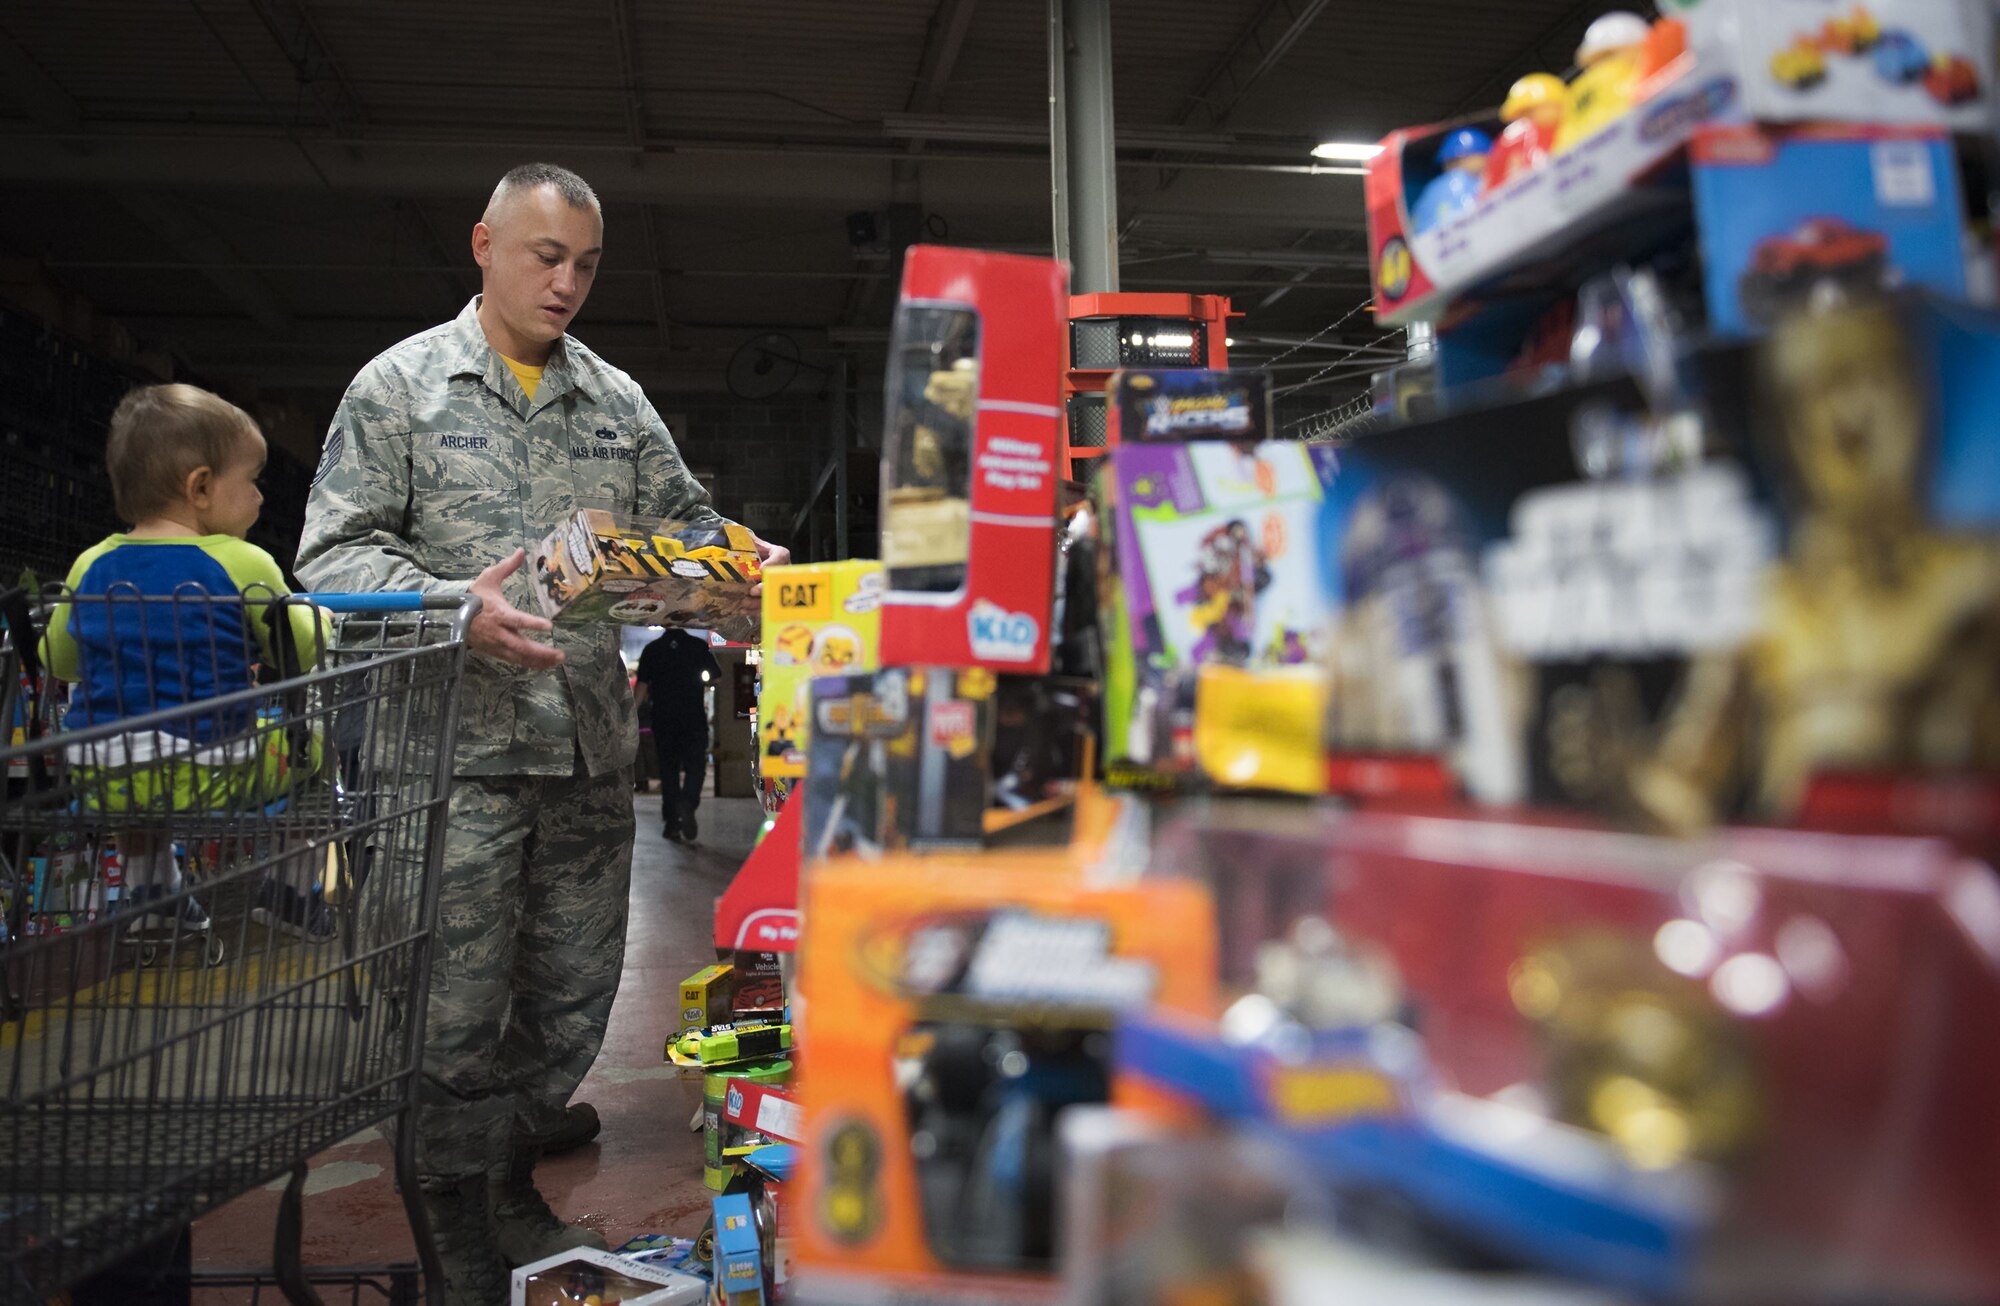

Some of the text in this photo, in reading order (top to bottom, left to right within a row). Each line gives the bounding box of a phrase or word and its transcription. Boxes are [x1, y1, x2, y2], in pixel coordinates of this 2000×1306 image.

[440, 434, 488, 449] ARCHER
[592, 446, 609, 459] AIR
[780, 584, 818, 608] CAT
[973, 614, 1034, 645] KID
[685, 991, 699, 1000] CAT
[711, 1023, 731, 1032] STAR
